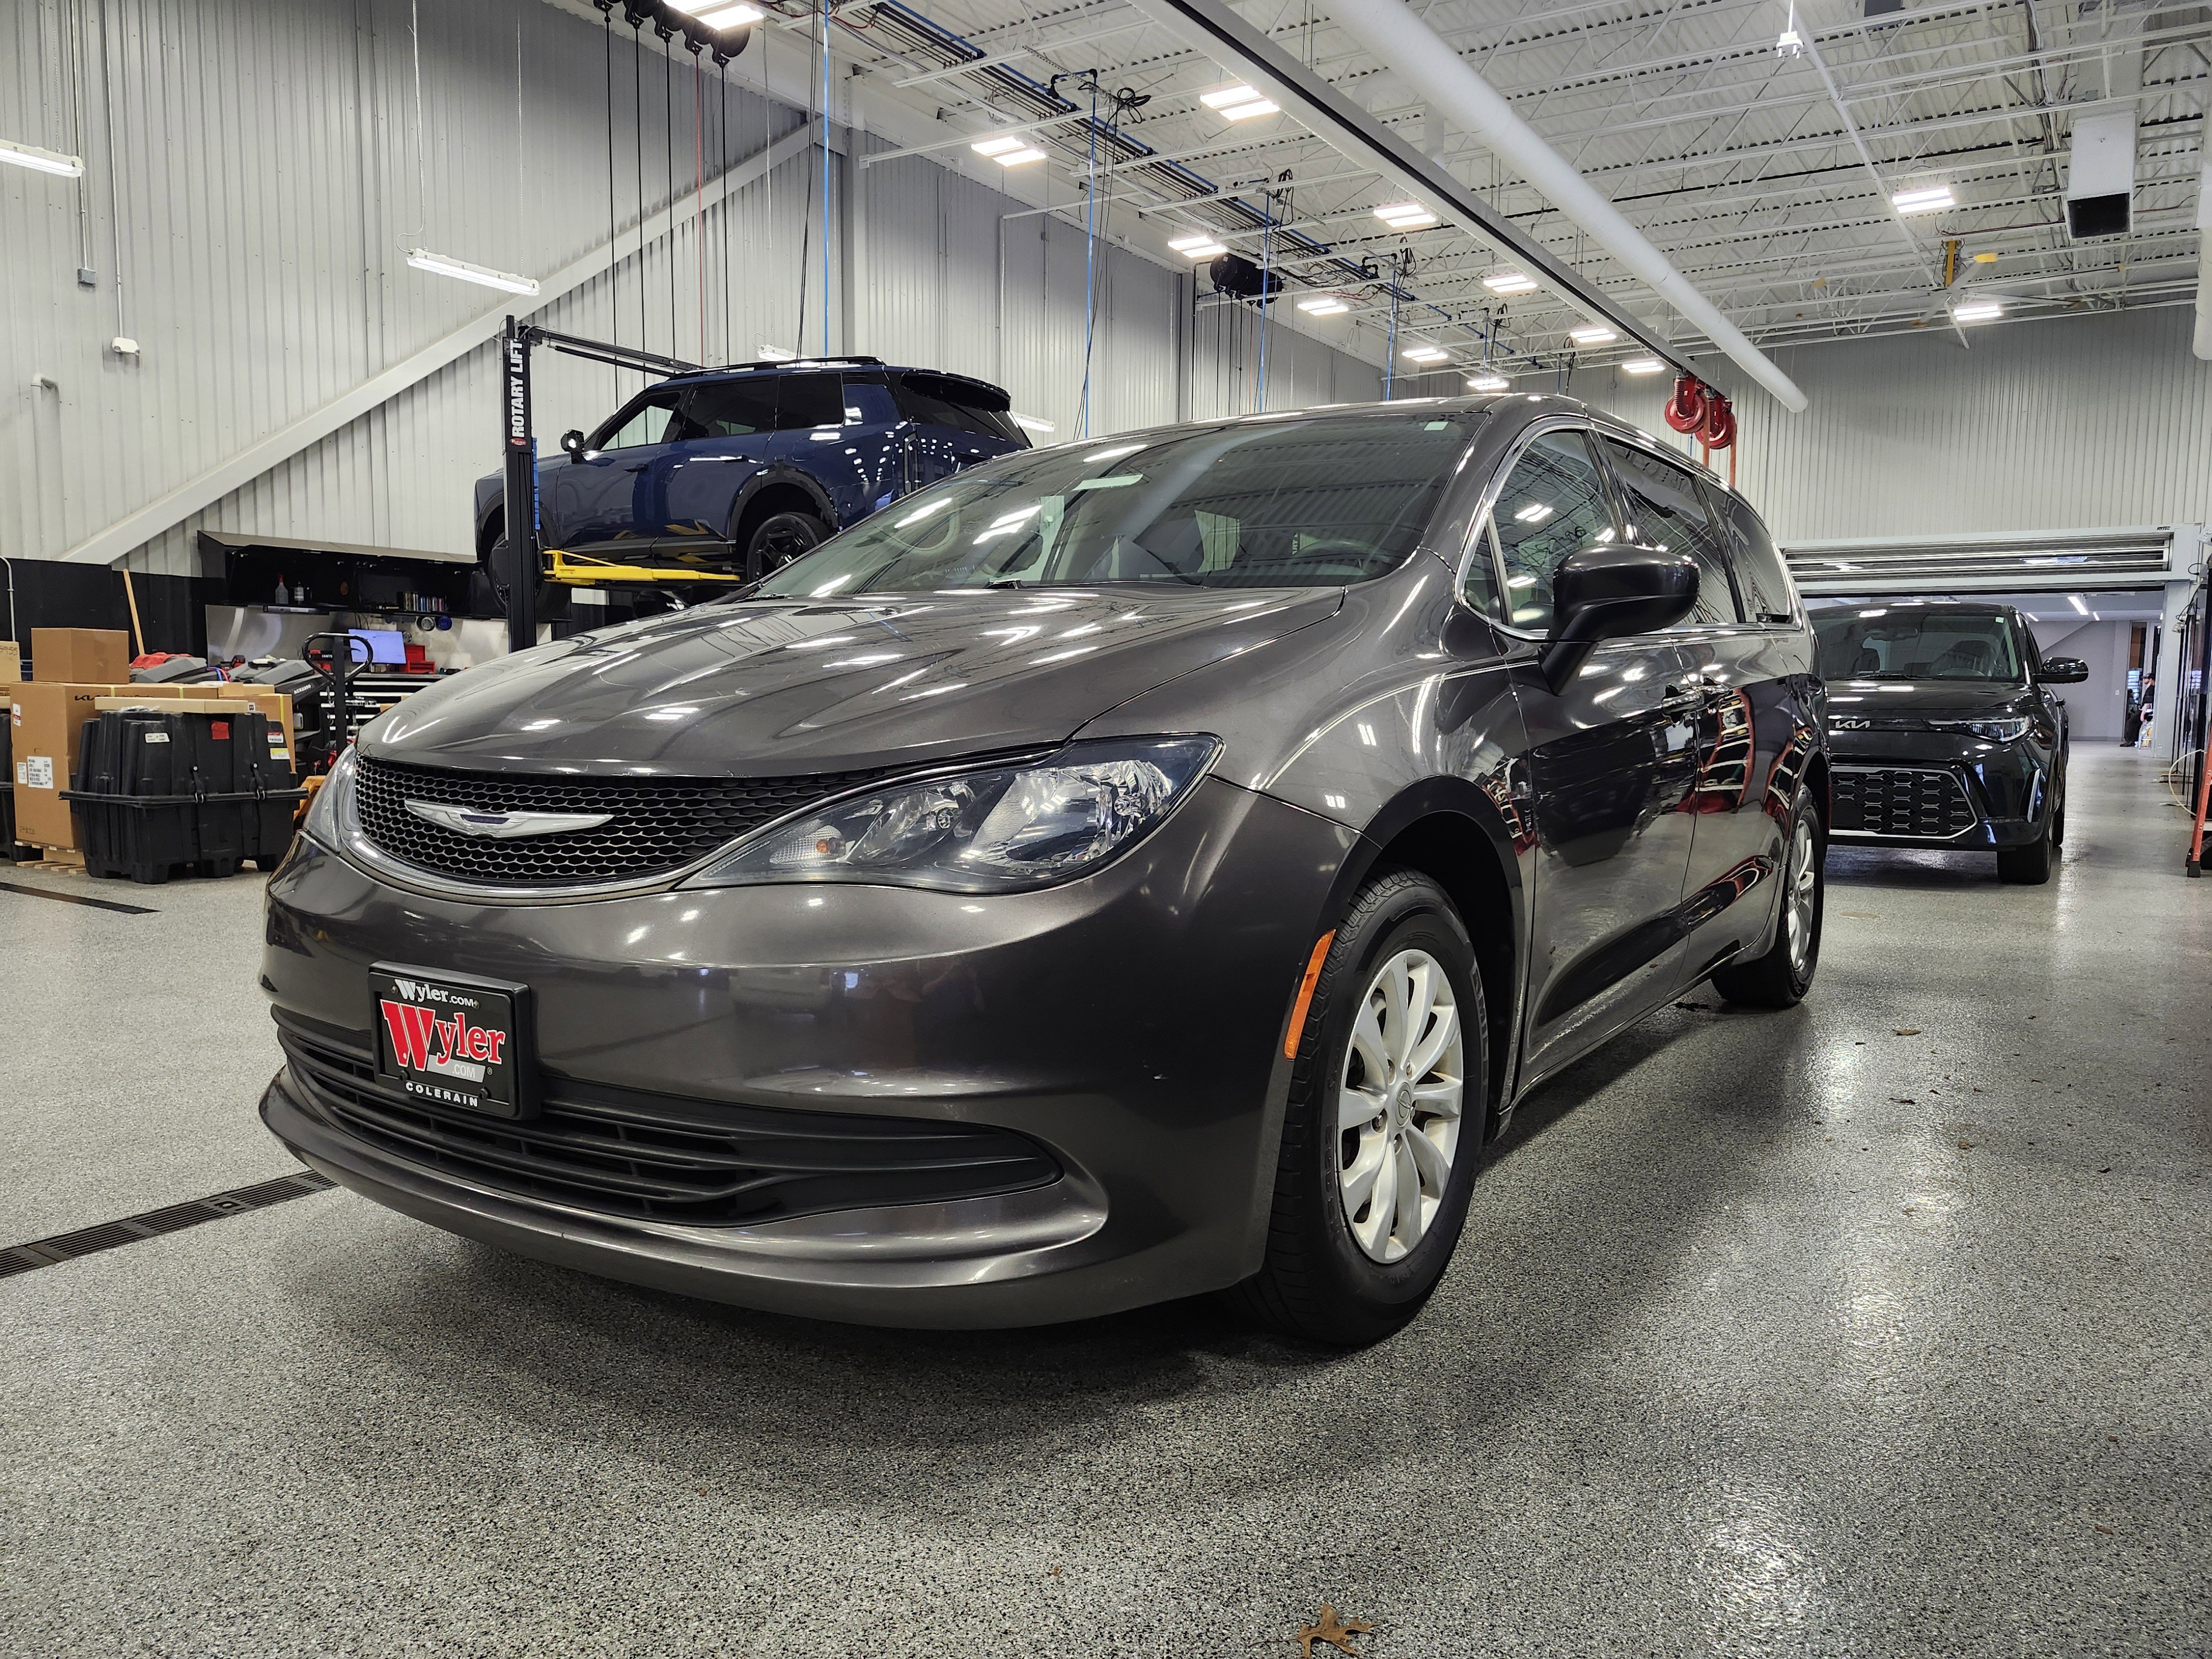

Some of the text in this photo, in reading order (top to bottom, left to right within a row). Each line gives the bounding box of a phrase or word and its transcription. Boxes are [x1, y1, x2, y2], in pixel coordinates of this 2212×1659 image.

[510, 338, 523, 373] LIFT
[510, 375, 525, 437] ROTARY
[1835, 720, 1870, 729] KIA
[380, 999, 506, 1072] Wyler
[405, 1082, 478, 1107] COLERAIN
